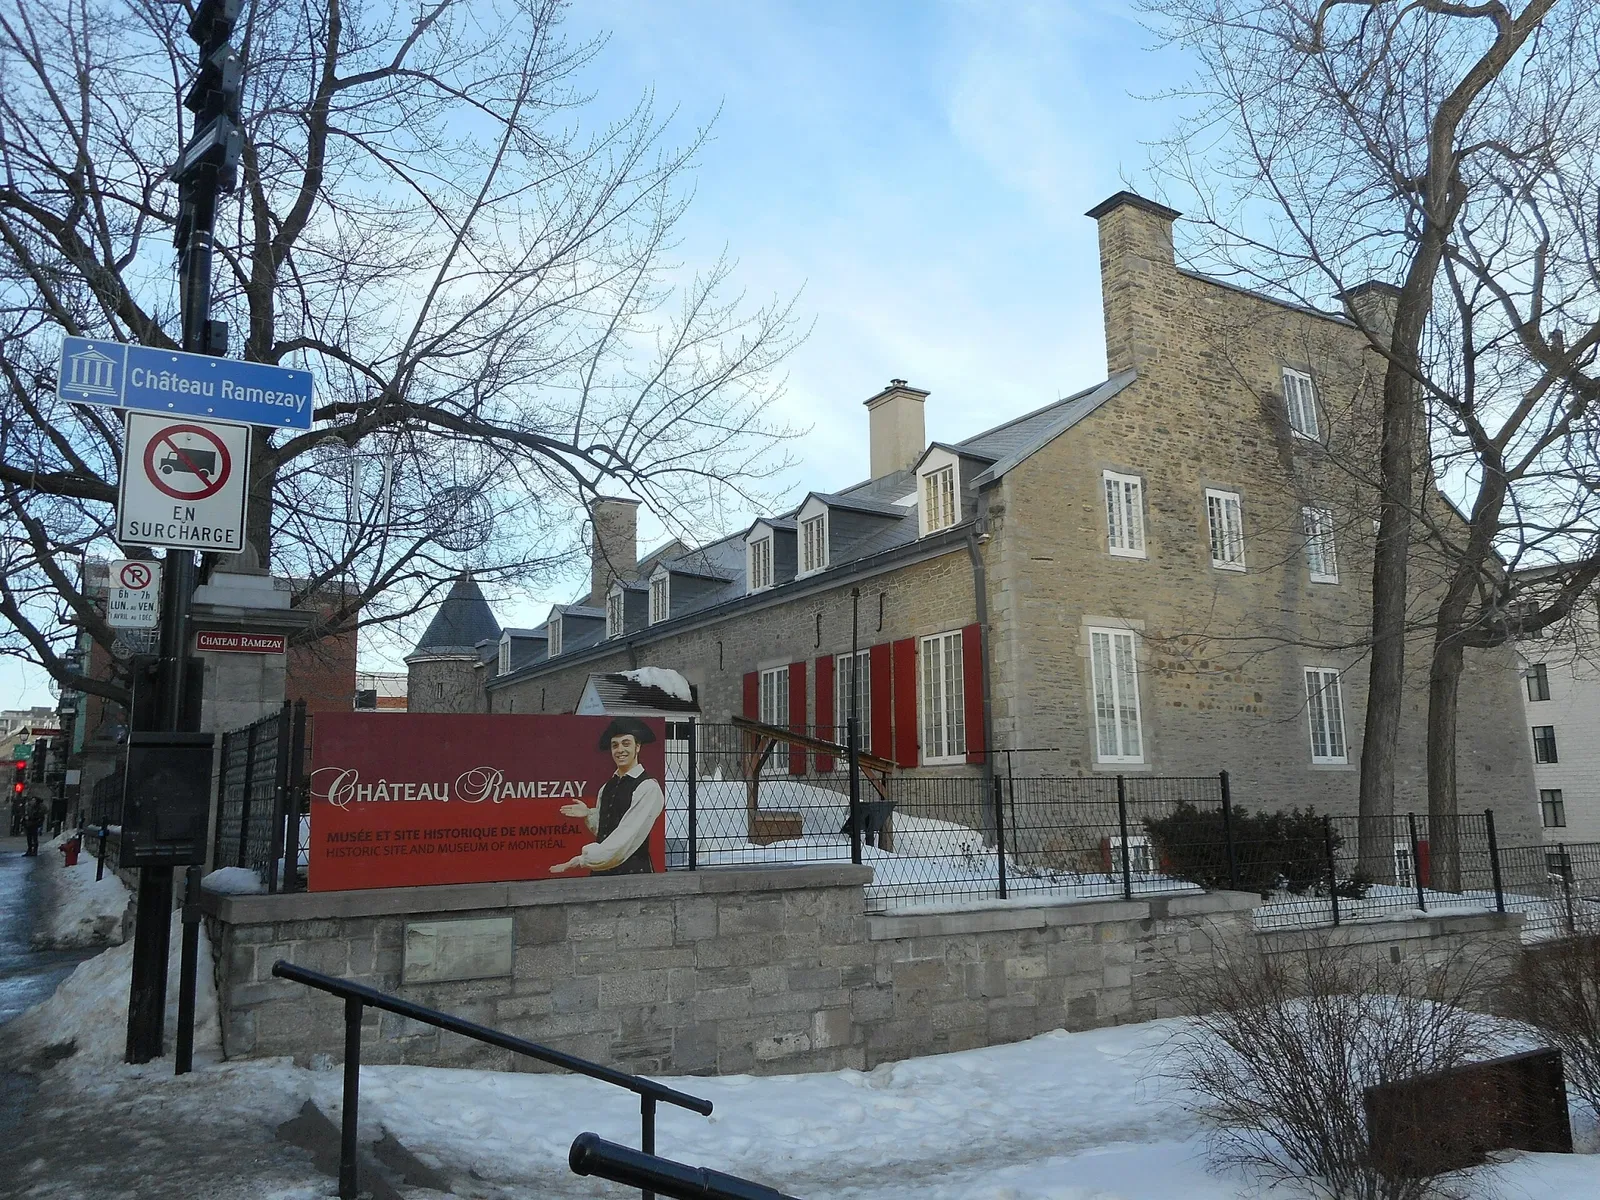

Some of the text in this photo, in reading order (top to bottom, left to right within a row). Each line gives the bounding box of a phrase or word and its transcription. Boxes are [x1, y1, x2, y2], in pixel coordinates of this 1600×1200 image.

[131, 368, 307, 413] Château Ramezay
[173, 505, 196, 521] EN
[129, 521, 235, 544] SURCHARGE
[110, 600, 129, 610] LUN.
[138, 602, 157, 612] VEN.
[200, 635, 282, 649] CHATEAU RAMEZAY
[311, 766, 588, 812] CHÂTEAU RAMEZAY
[326, 822, 583, 843] MUSÉE ET SITE HISTORIQUE DE MONTRÉAL
[326, 837, 567, 858] HISTORIC SITE AND MUSEUM OF MONTRÉAL
